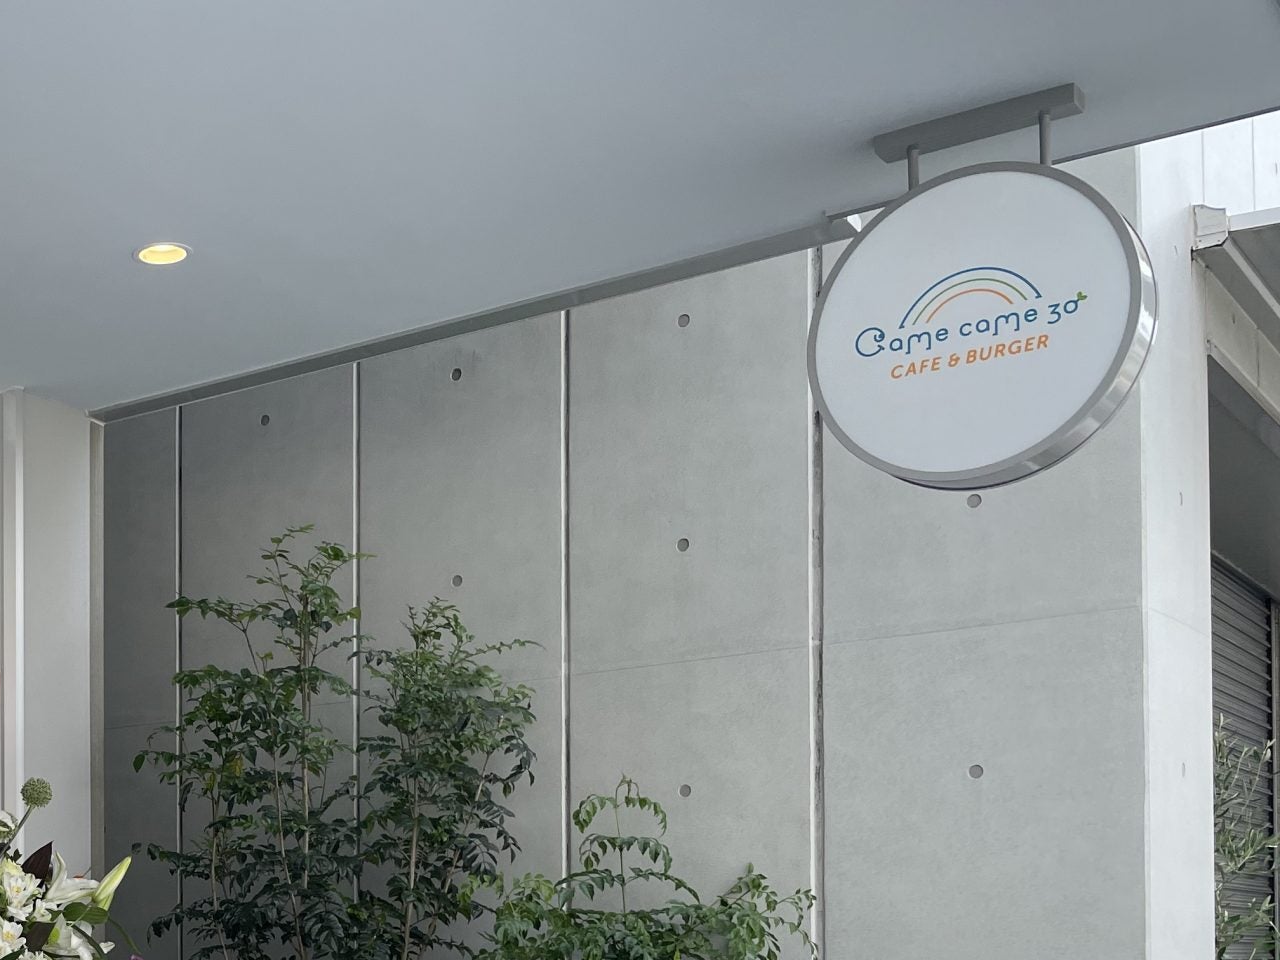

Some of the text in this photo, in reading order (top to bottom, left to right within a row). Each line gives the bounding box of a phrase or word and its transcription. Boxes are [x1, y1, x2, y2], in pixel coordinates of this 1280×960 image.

[855, 298, 1080, 357] Came came 30
[890, 334, 1049, 379] CAFE & BURGER
